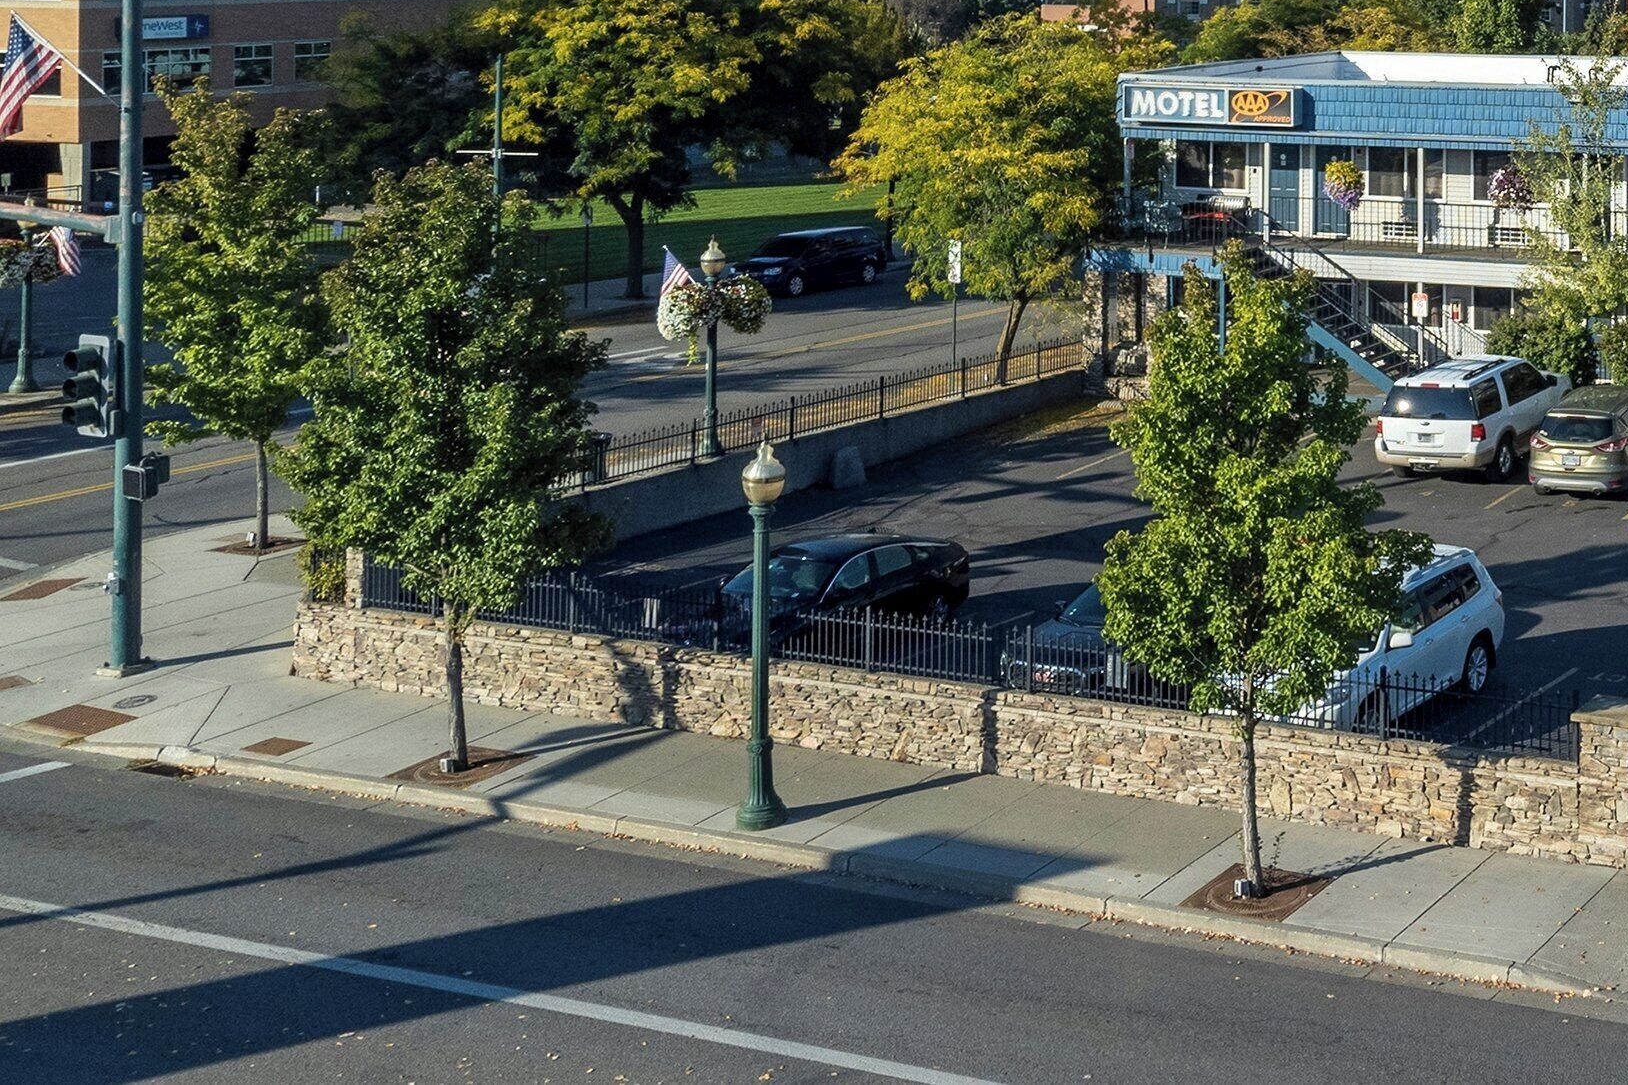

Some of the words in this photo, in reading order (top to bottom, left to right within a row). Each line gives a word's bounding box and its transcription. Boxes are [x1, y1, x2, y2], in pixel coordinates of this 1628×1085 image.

[1130, 89, 1224, 118] MOTEL
[1235, 92, 1266, 113] AAA
[1252, 115, 1291, 123] APPROVED
